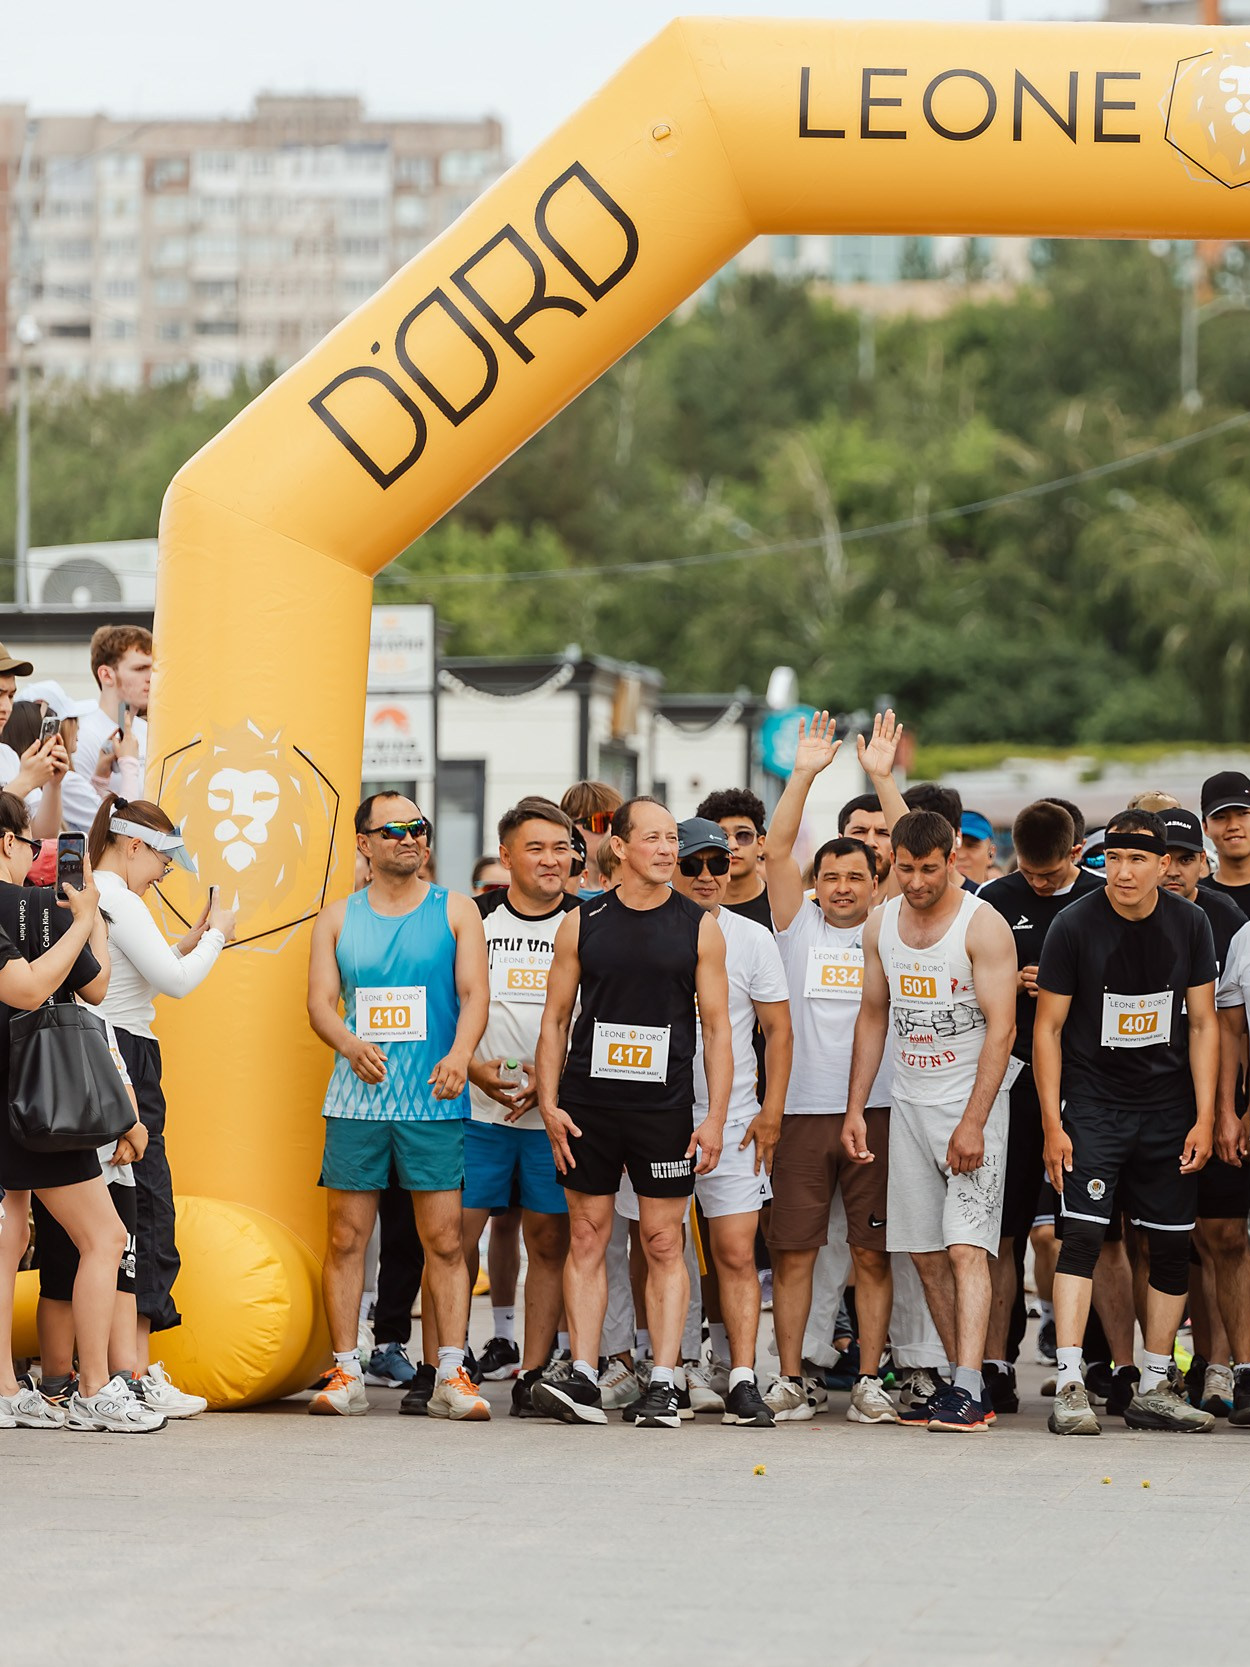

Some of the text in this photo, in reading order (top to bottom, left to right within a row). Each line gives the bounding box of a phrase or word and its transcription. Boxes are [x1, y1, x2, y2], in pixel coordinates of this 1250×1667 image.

[798, 65, 1142, 144] LEONE
[19, 900, 27, 941] Calvin Klein
[42, 925, 50, 948] Calvin
[892, 962, 912, 971] LEONE
[511, 971, 547, 988] 335
[825, 967, 860, 985] 334
[903, 978, 931, 996] 501
[361, 994, 383, 1002] LEONE
[1110, 1000, 1135, 1009] LEONE
[372, 1008, 406, 1026] 410
[1122, 1014, 1155, 1033] 407
[600, 1030, 626, 1039] LEONE
[611, 1046, 648, 1065] 417
